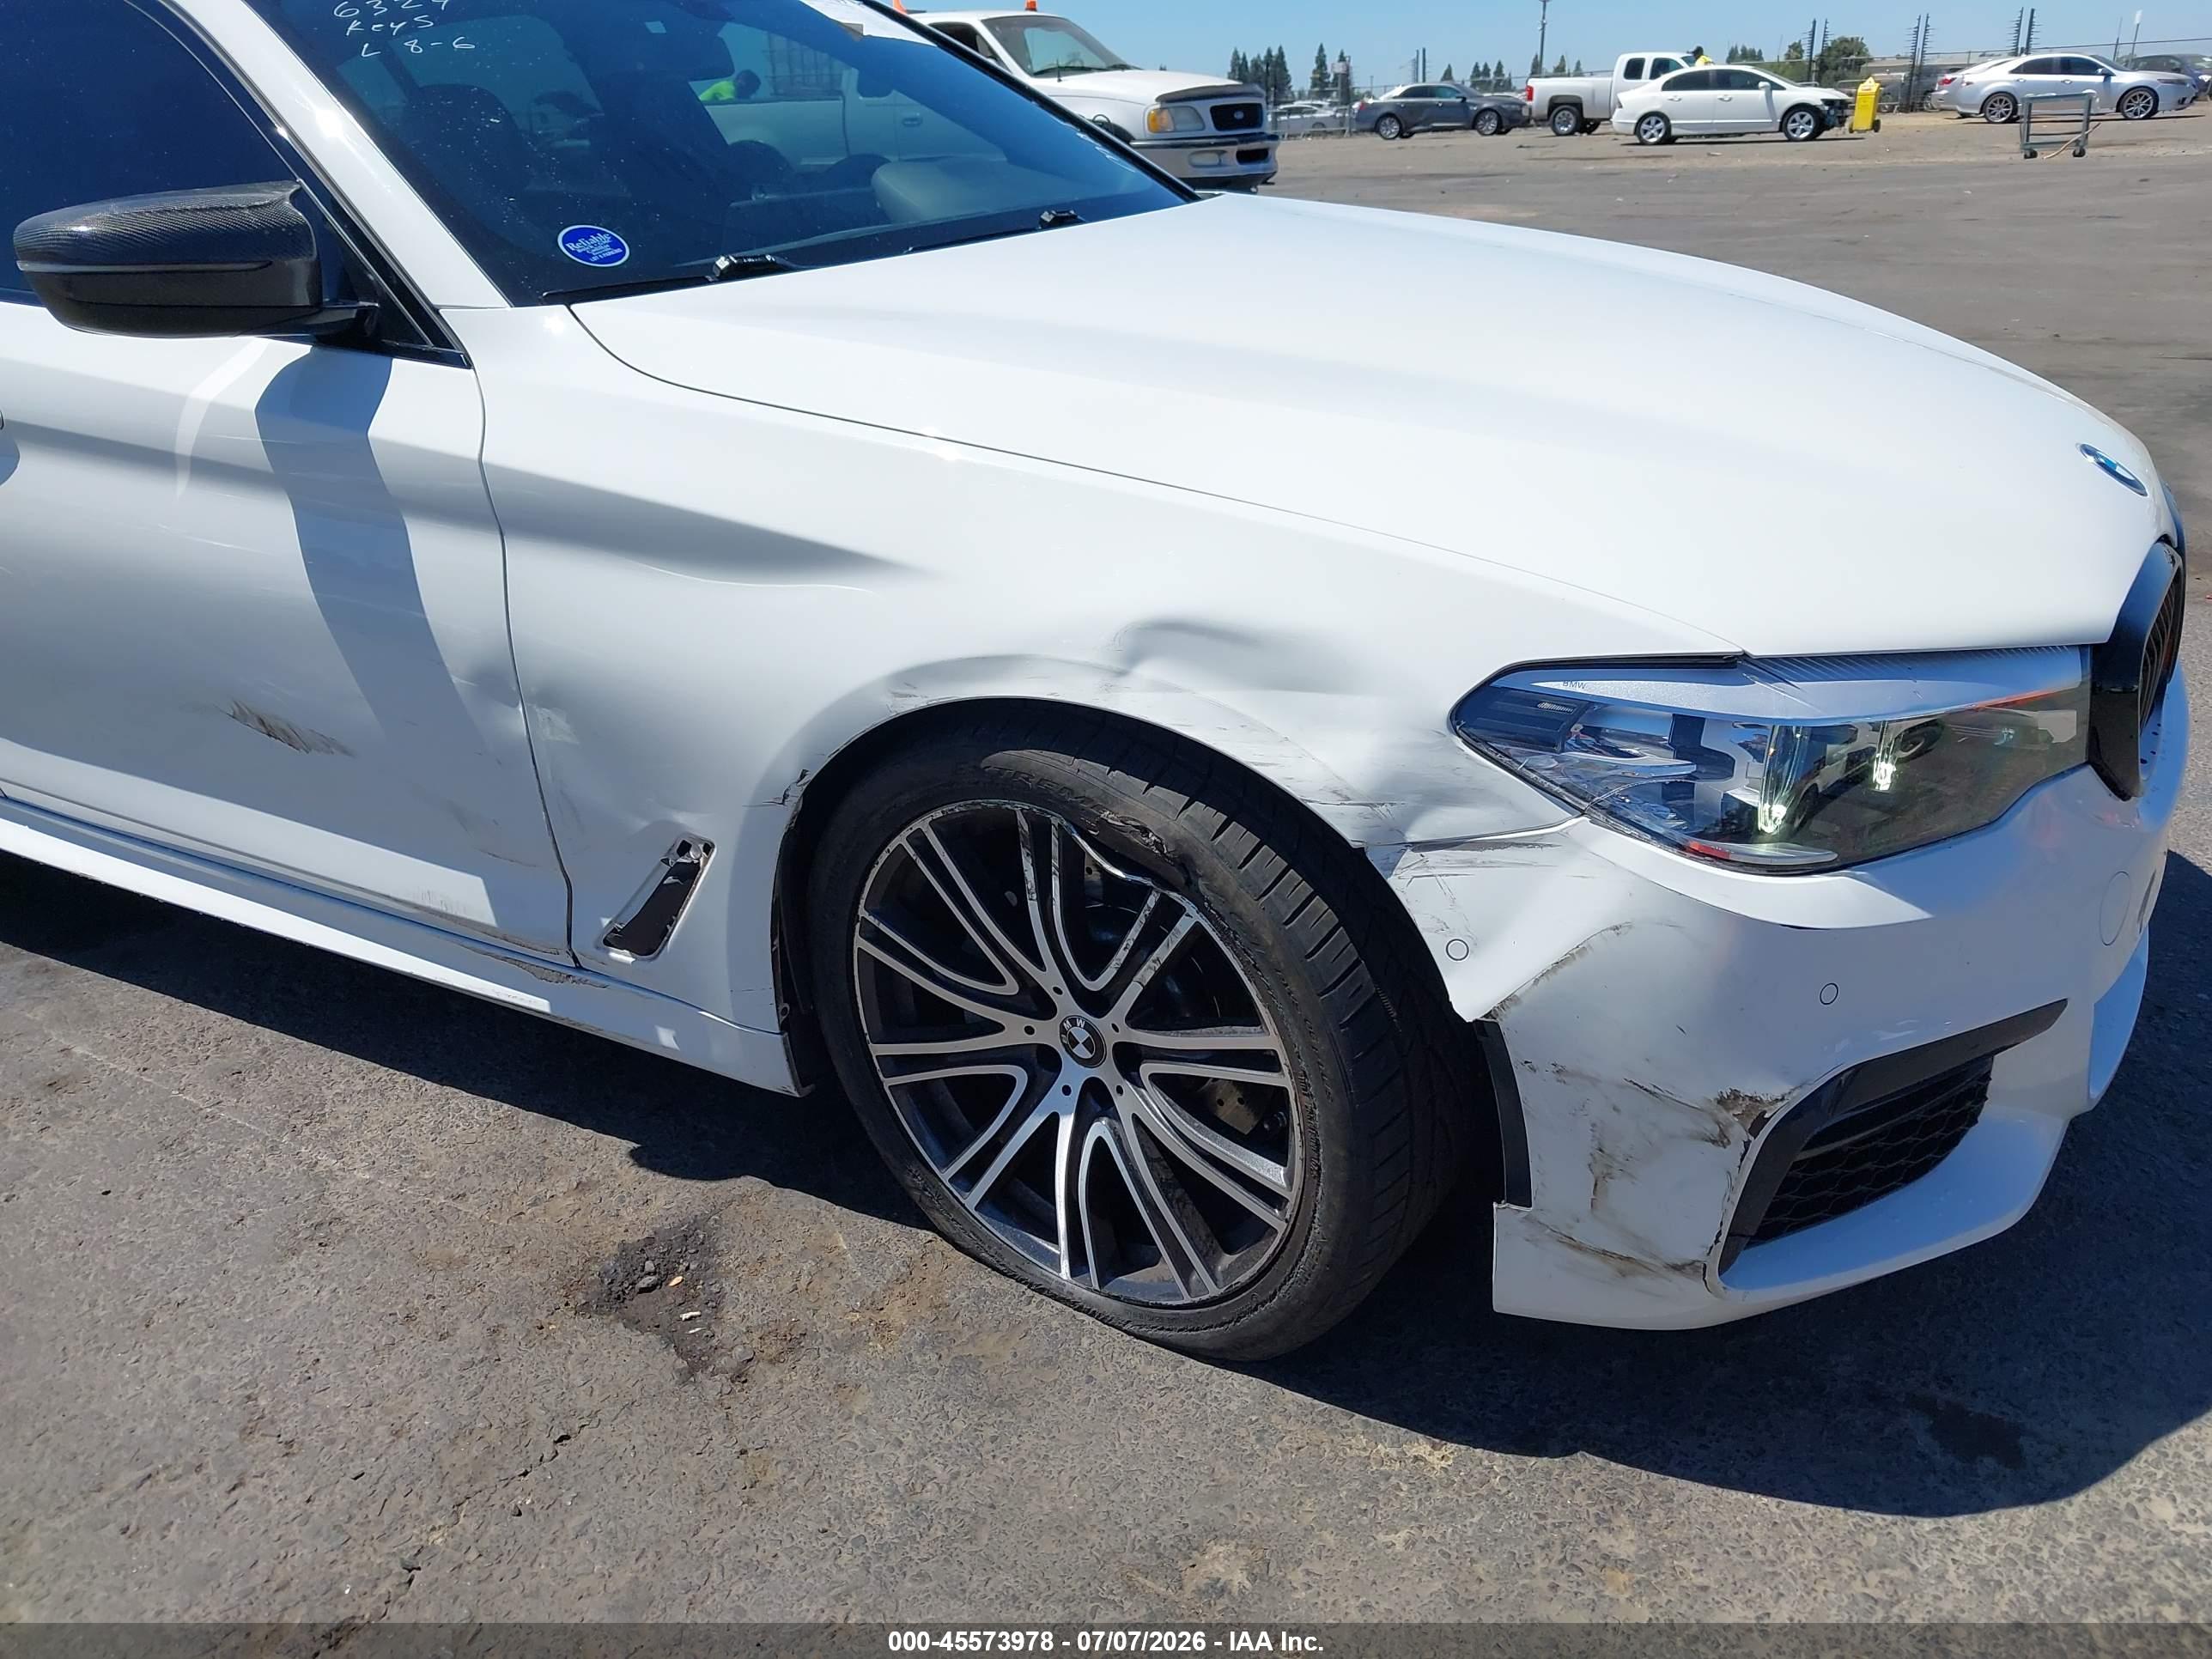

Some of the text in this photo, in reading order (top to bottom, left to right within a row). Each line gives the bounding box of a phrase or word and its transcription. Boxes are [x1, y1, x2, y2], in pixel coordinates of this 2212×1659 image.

[565, 233, 611, 252] Reliable
[1562, 680, 1587, 690] BMW
[1061, 1018, 1085, 1045] BMW
